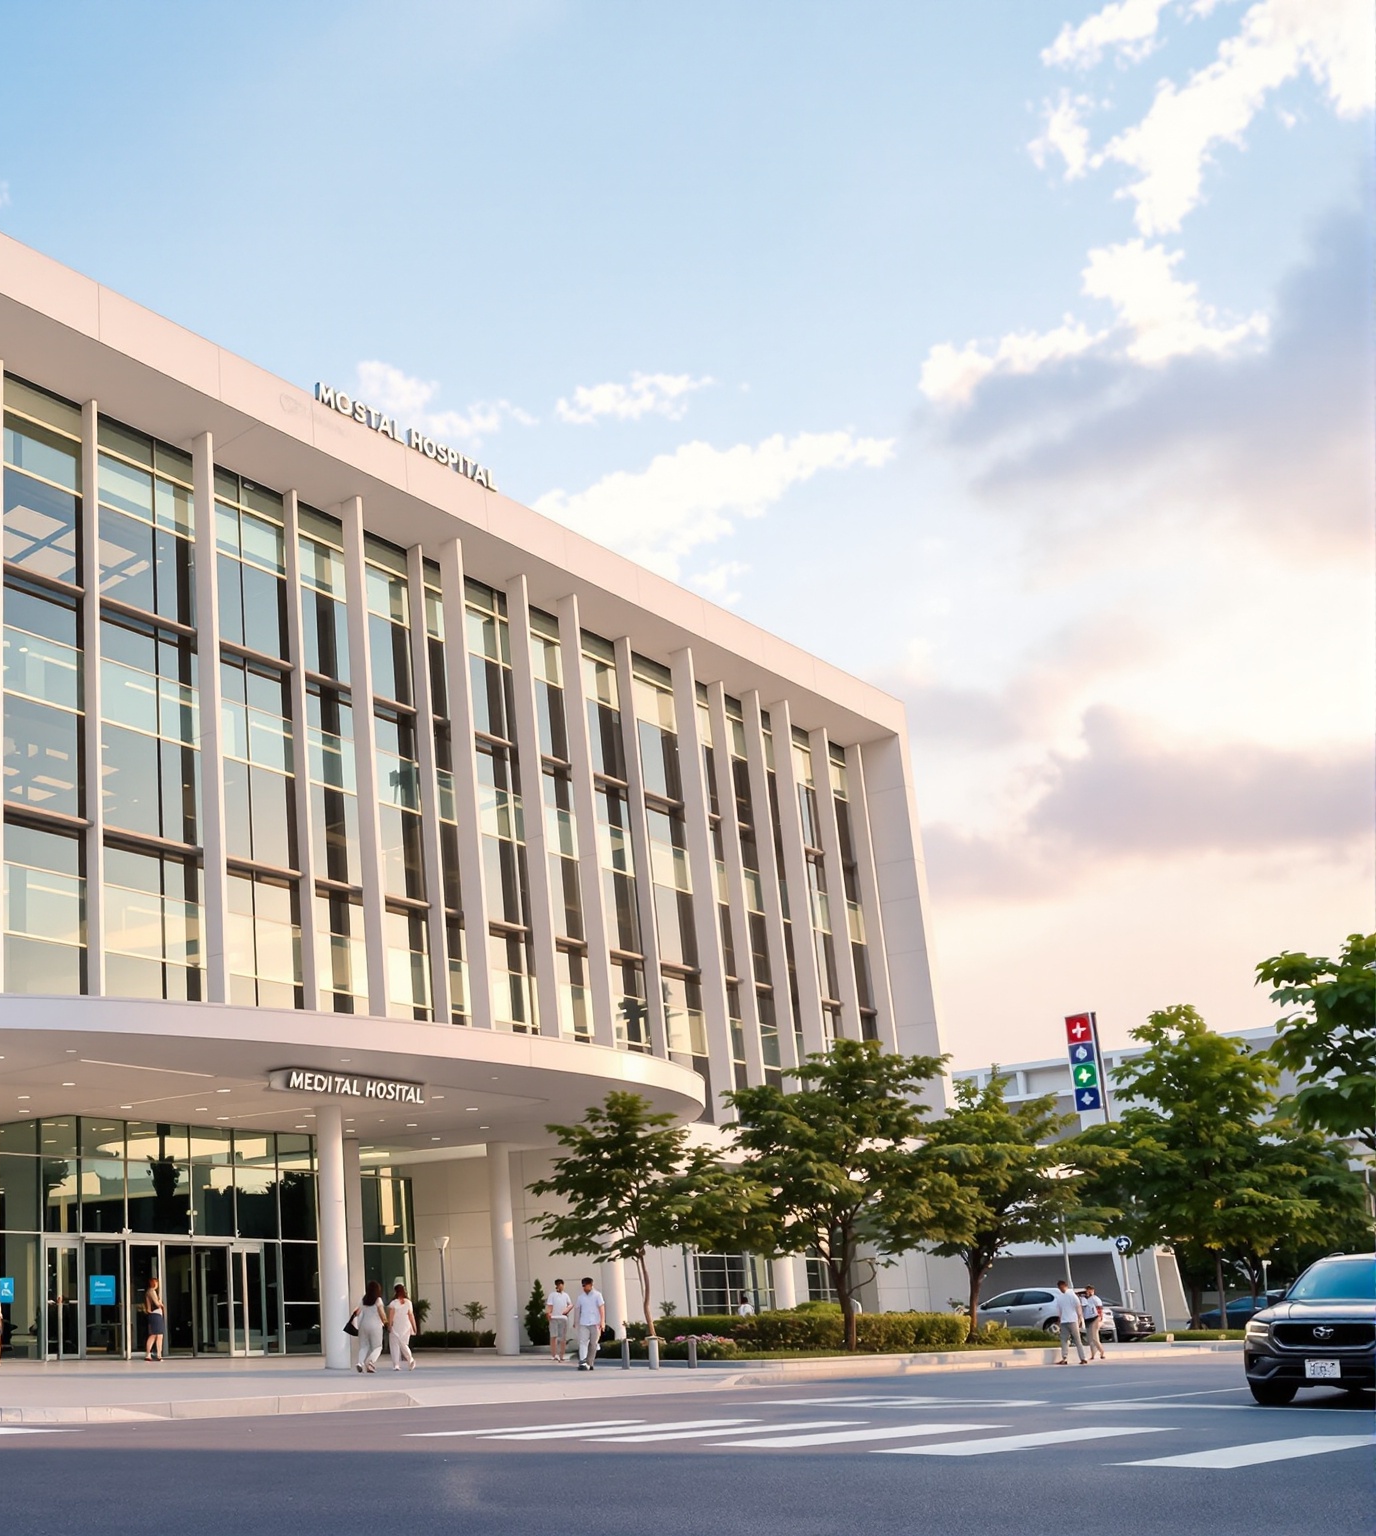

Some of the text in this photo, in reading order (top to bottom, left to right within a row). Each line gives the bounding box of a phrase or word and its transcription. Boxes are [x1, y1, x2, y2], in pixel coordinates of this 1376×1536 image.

[315, 382, 498, 492] MOSTAL HOSPITAL
[289, 1071, 425, 1104] MEDITAL HOSITAL
